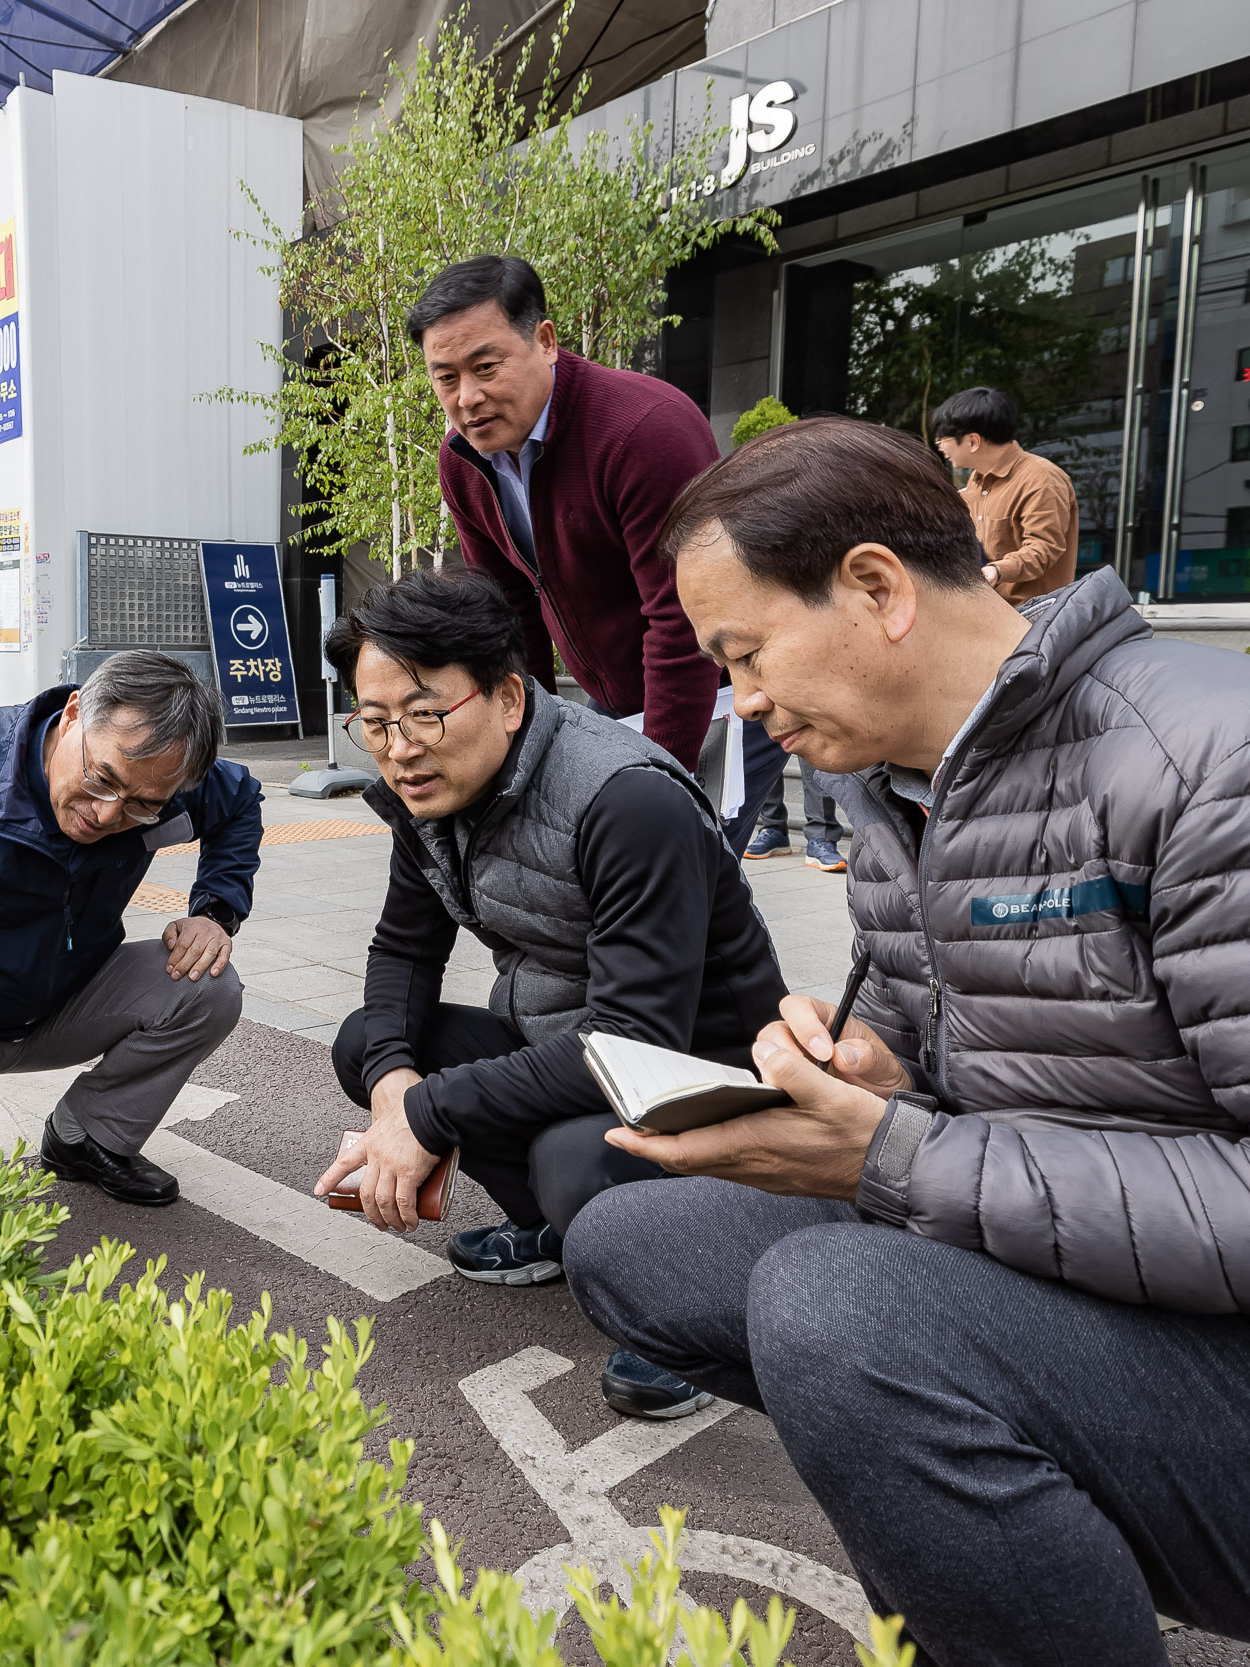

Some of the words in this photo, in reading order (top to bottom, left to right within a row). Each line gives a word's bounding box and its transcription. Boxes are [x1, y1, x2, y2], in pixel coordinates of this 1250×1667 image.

[720, 79, 797, 189] JS
[750, 143, 816, 175] BUILDING
[229, 658, 282, 682] 주차장
